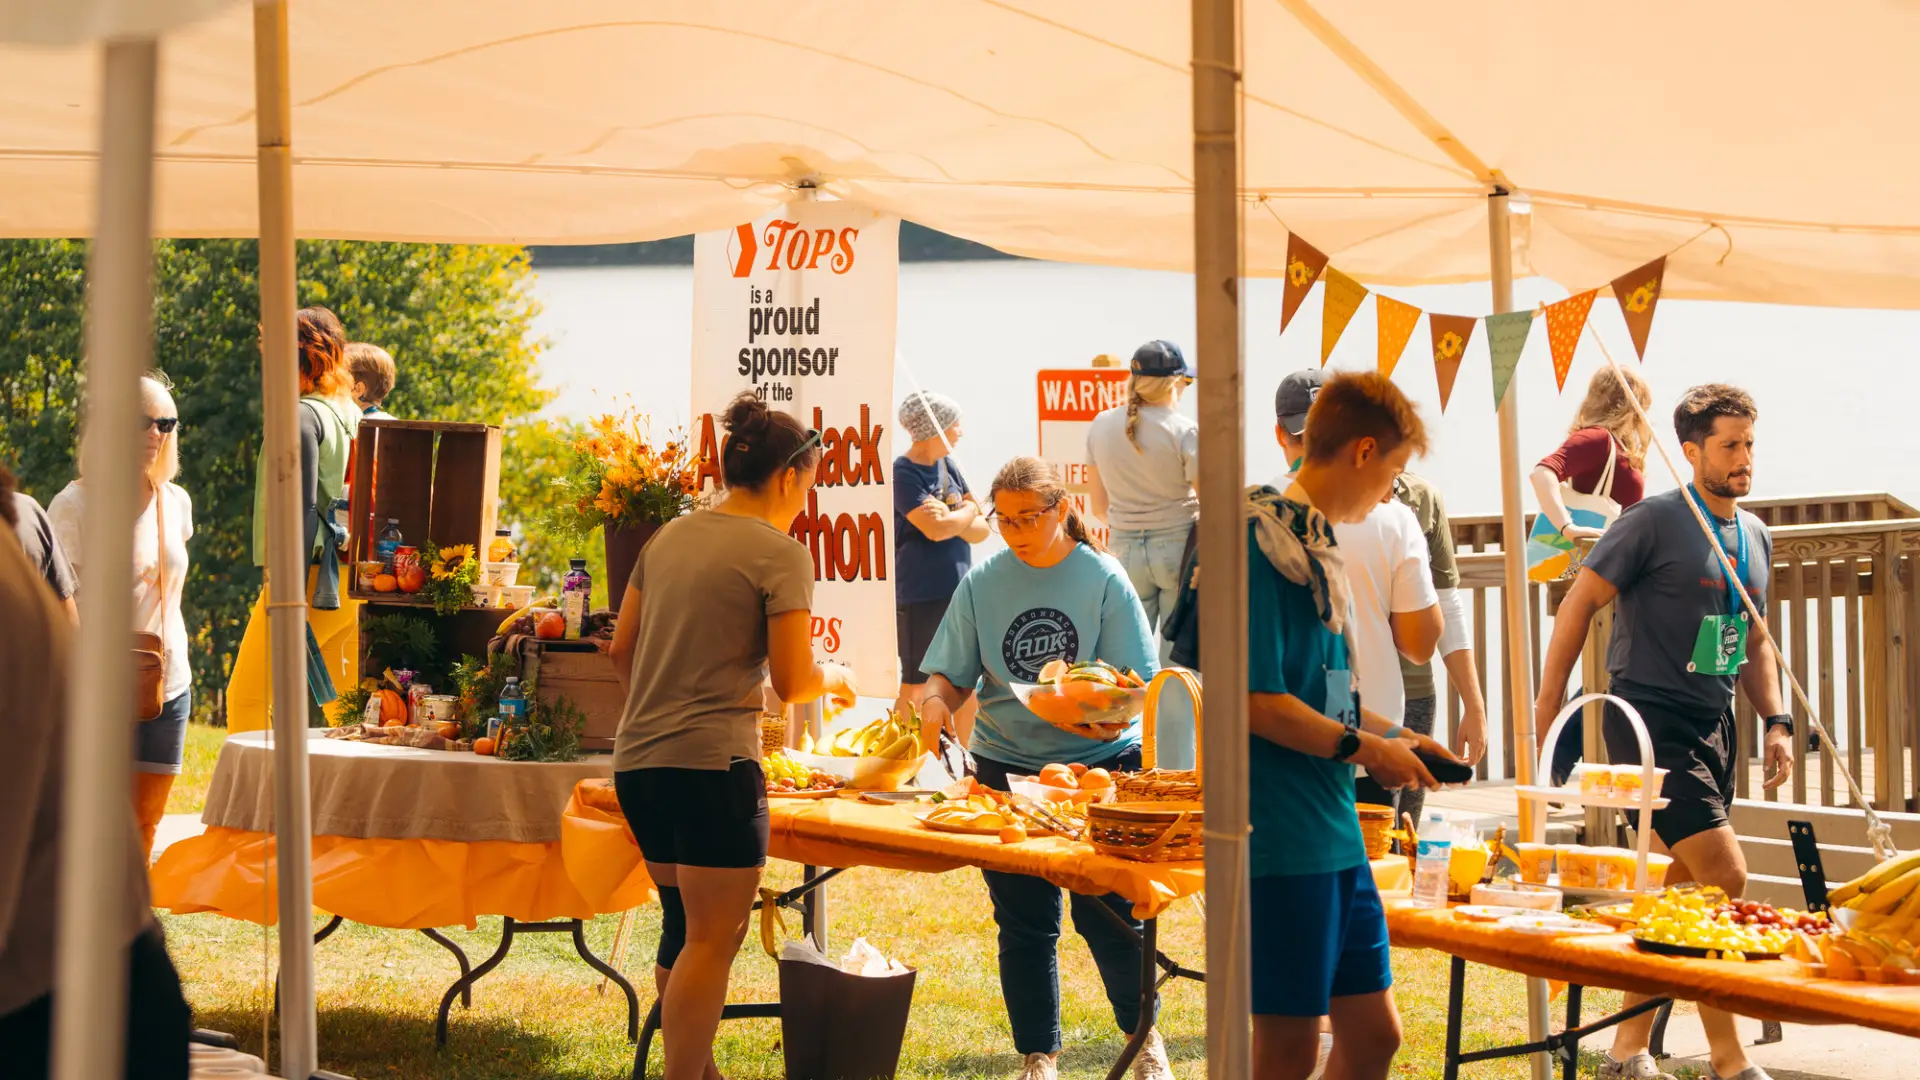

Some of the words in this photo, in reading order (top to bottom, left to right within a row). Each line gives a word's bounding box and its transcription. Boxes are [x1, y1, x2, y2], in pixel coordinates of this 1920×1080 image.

[763, 219, 860, 275] TOPS
[750, 285, 762, 304] is
[765, 289, 773, 304] a
[748, 297, 820, 344] proud
[737, 347, 839, 384] sponsor
[755, 382, 769, 401] of
[772, 382, 793, 401] the
[810, 616, 842, 653] PS
[1014, 631, 1067, 659] ADK
